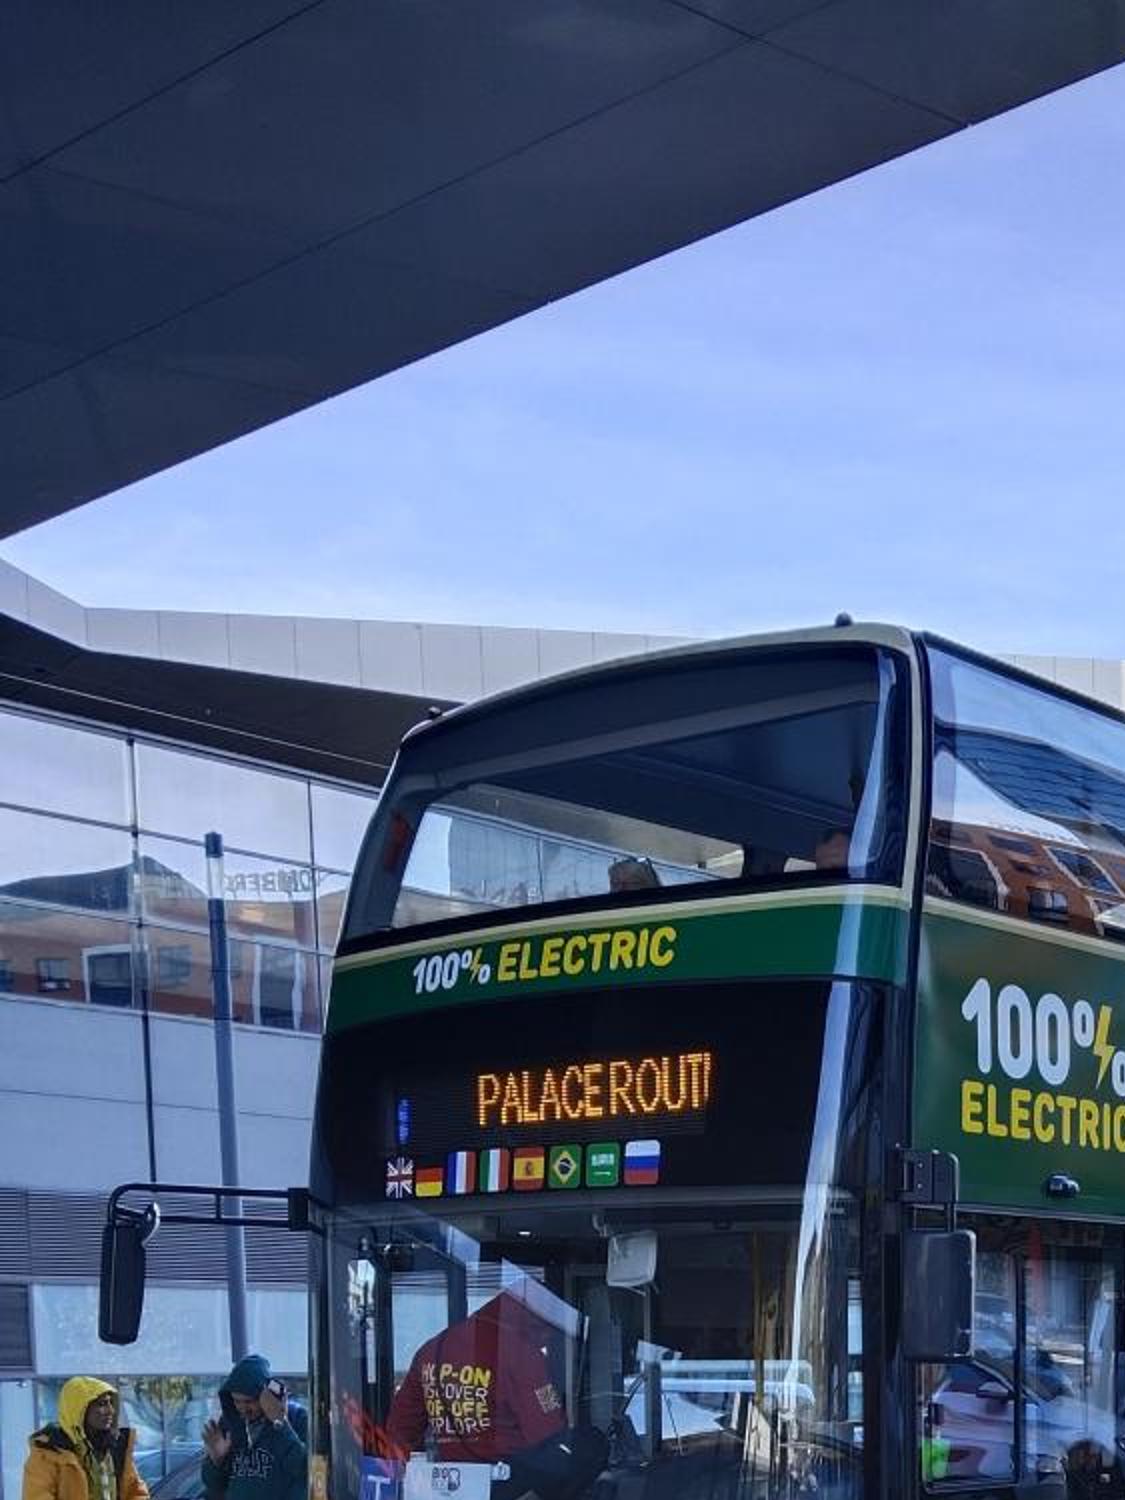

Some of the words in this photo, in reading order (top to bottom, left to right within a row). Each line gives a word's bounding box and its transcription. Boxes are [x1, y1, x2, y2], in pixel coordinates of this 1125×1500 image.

[413, 947, 492, 994] 100%
[496, 927, 677, 981] ELECTRIC
[477, 1063, 604, 1126] PALACE
